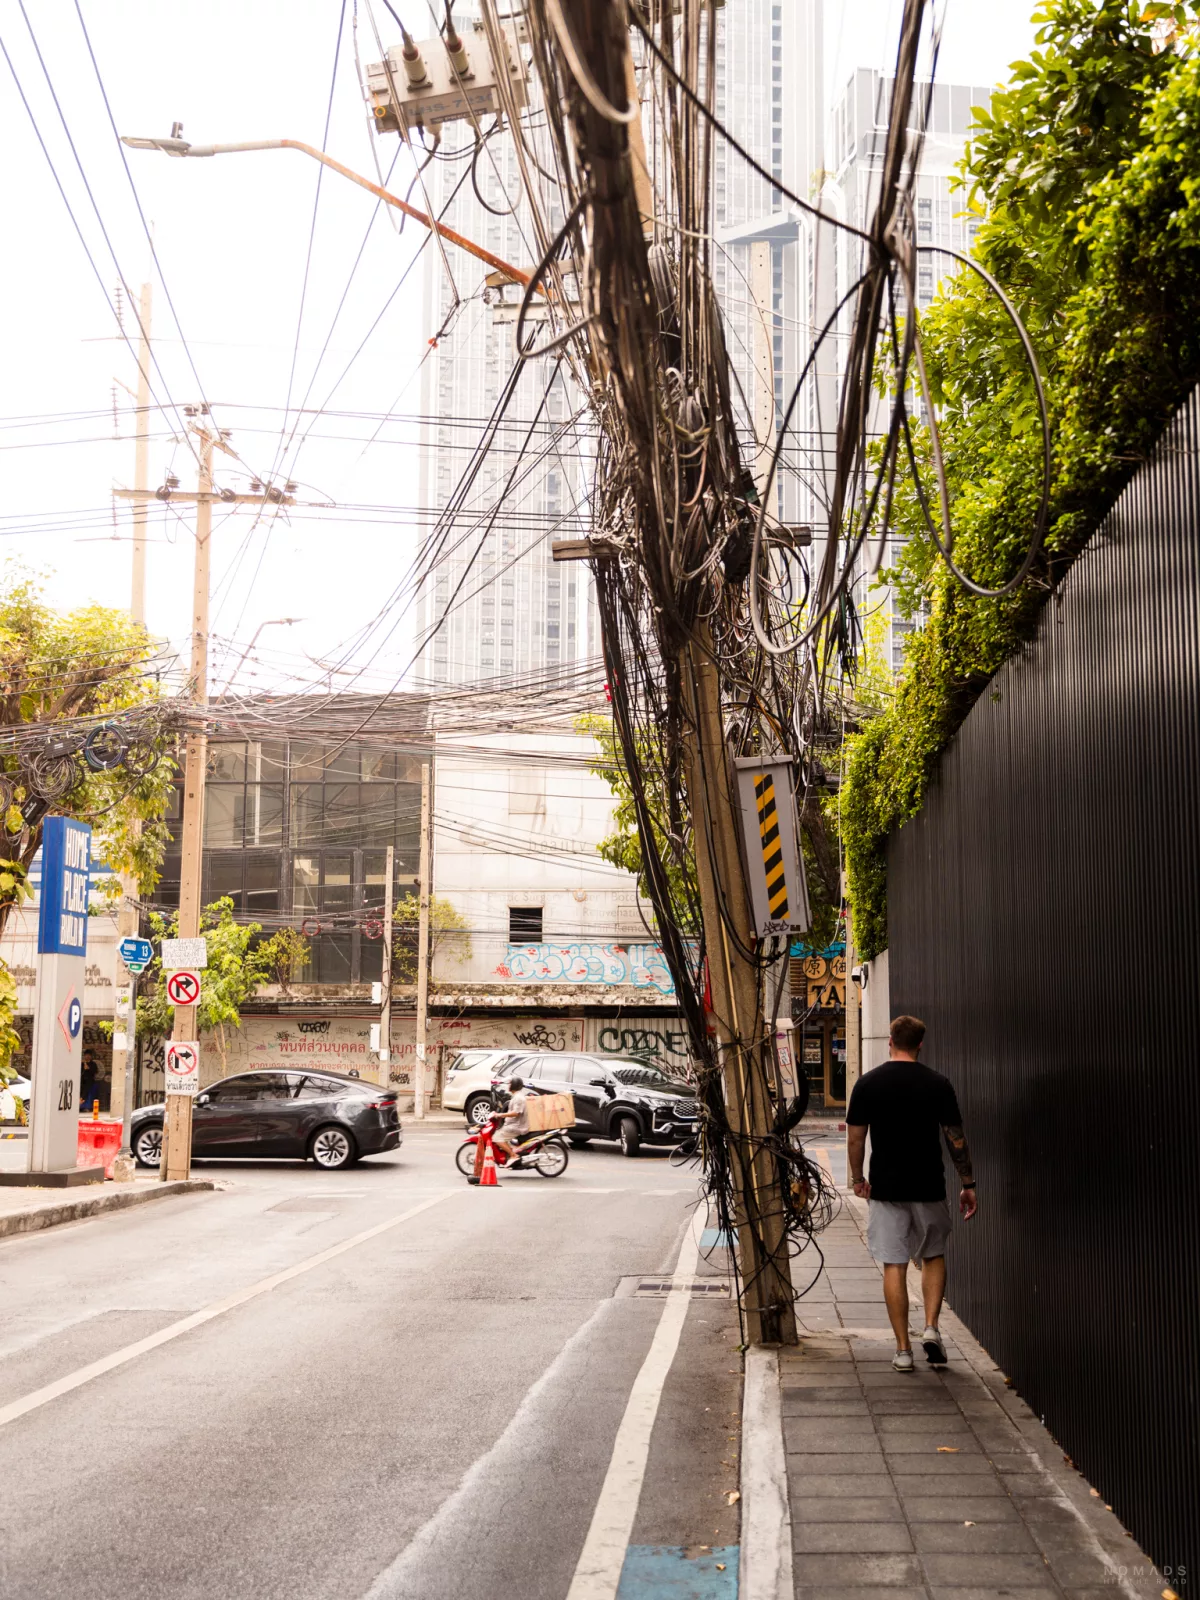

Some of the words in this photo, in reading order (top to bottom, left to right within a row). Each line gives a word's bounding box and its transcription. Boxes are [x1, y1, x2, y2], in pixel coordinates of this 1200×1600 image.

[65, 827, 89, 871] HOME
[62, 870, 88, 914] PLACE
[141, 945, 149, 957] 13
[71, 1005, 80, 1031] P
[58, 1079, 73, 1111] 283
